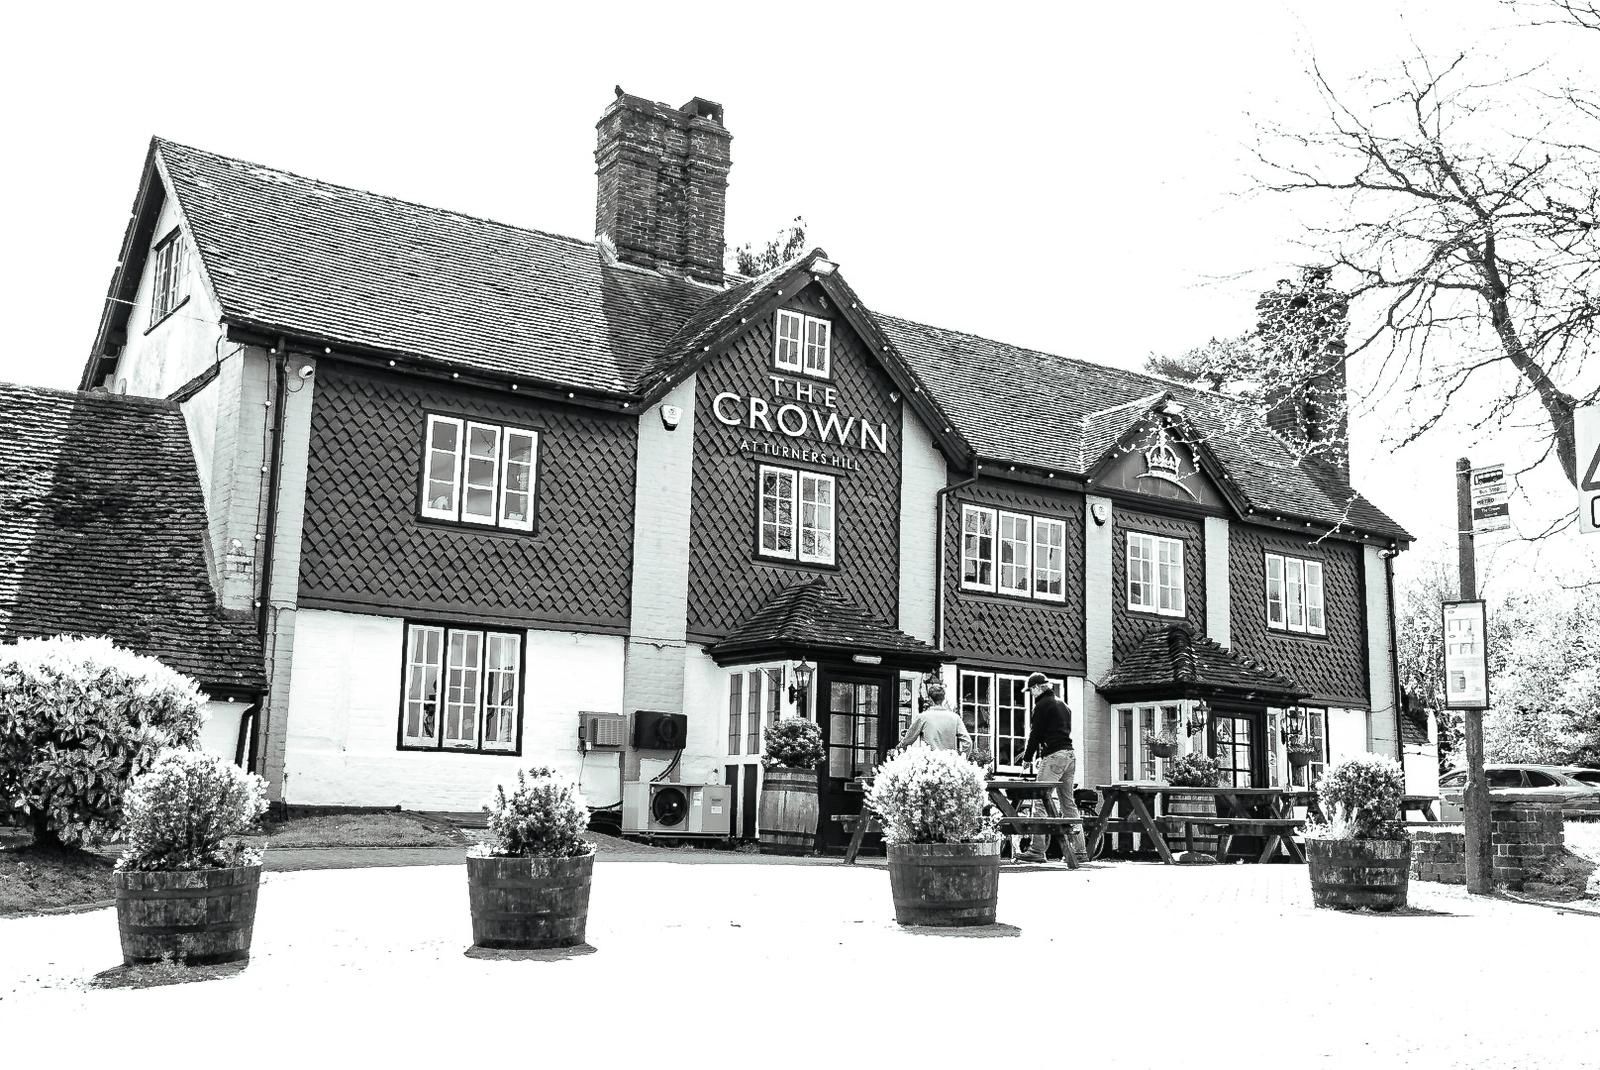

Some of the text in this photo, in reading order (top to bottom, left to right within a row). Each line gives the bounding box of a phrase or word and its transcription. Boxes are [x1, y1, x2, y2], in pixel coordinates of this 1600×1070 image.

[769, 375, 837, 408] THE
[712, 391, 887, 454] CROWN
[740, 440, 860, 472] AT TURNERS HILL
